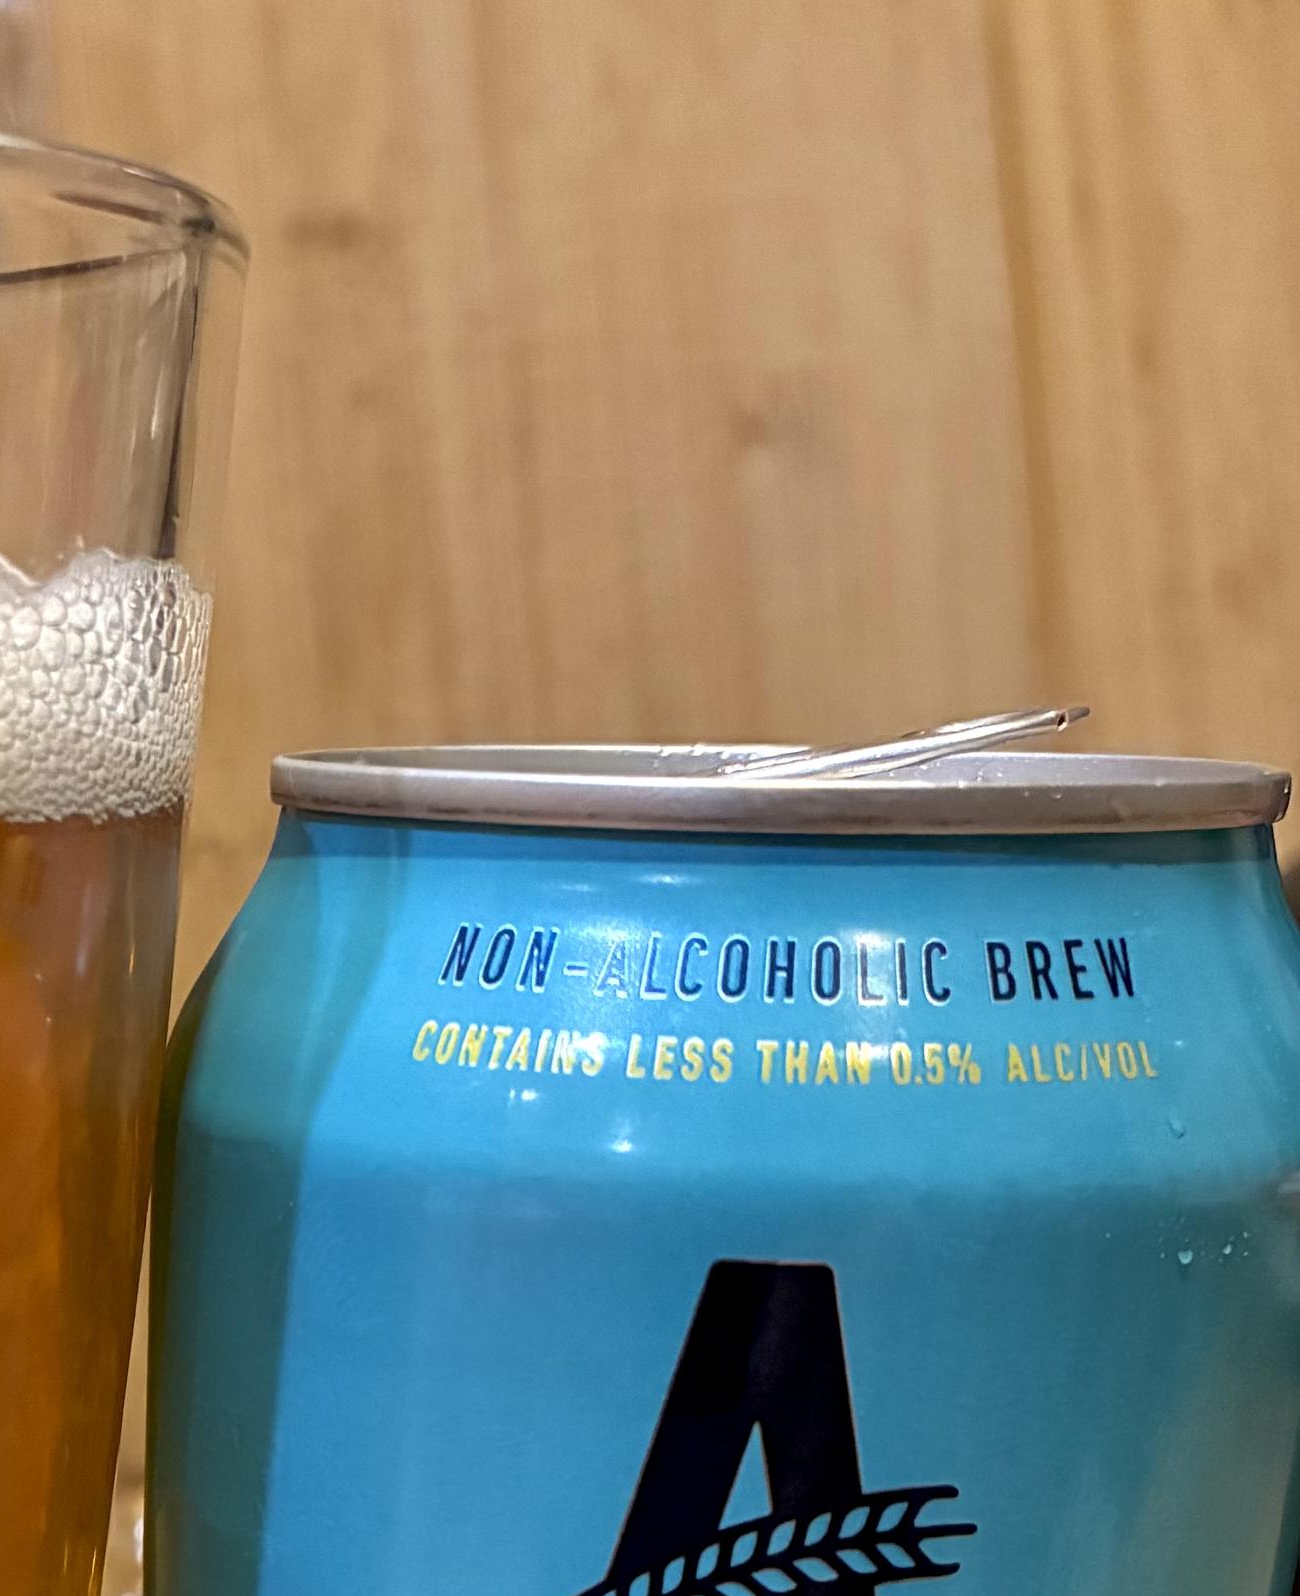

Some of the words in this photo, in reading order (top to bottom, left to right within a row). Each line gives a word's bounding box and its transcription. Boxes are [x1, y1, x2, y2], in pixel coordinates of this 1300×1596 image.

[437, 922, 951, 1006] NON-ALCOHOLIC
[984, 936, 1136, 1004] BREW
[412, 1019, 608, 1077] CONTAINS
[625, 1033, 734, 1083] LESS
[756, 1040, 872, 1086] THAN
[890, 1041, 982, 1086] 0.5%
[1007, 1040, 1159, 1084] ALC/VOL
